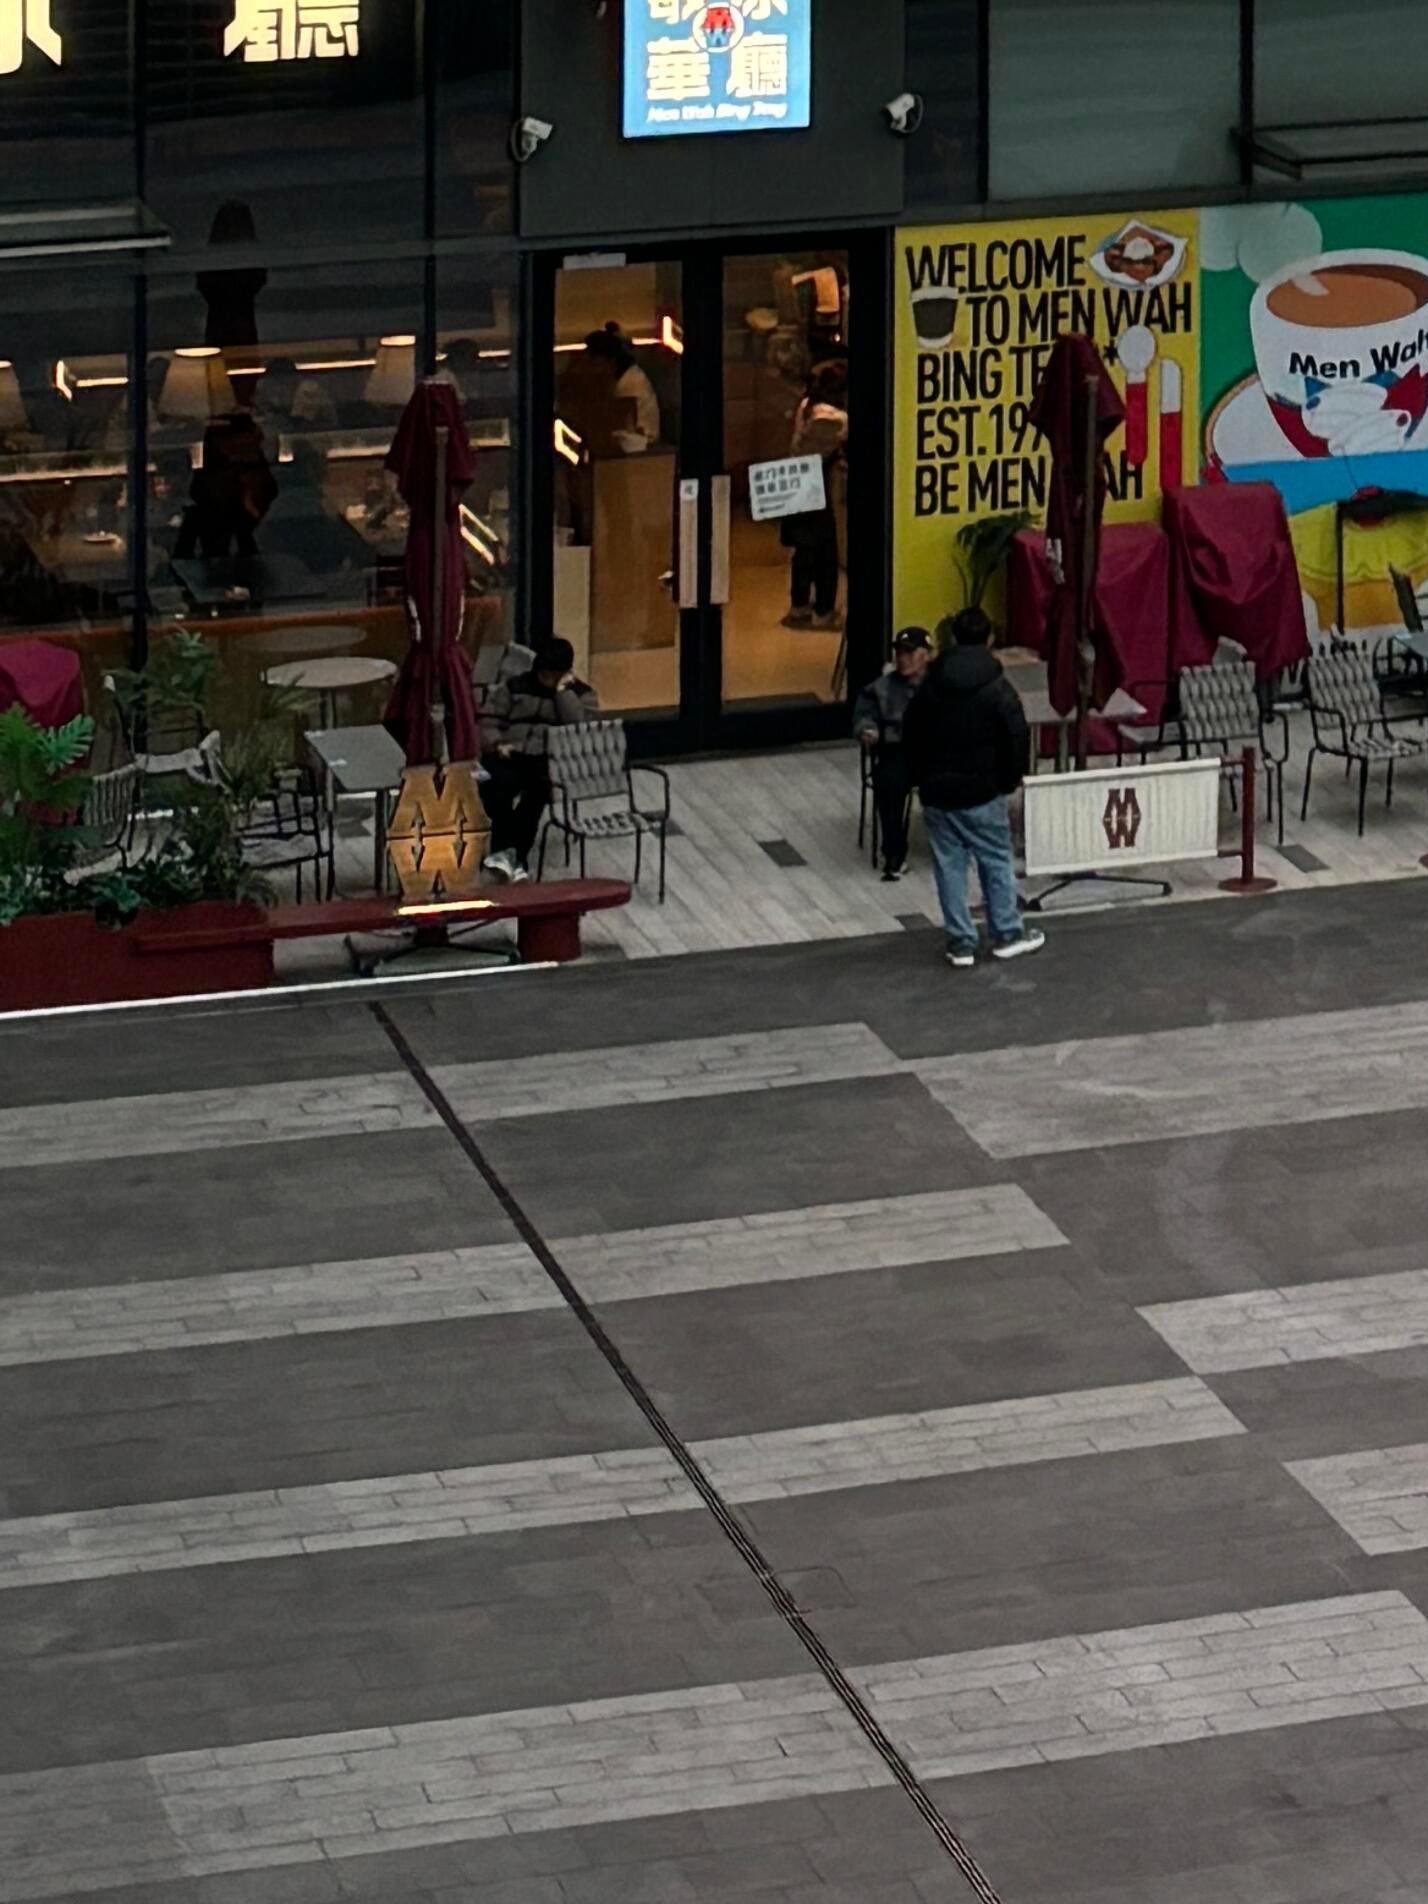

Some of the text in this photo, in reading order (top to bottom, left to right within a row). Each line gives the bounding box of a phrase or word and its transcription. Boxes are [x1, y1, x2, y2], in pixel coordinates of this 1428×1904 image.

[905, 233, 1087, 293] WELCOME
[966, 280, 1192, 348] TO MEN WAH
[916, 347, 1002, 405] BING
[1288, 351, 1361, 379] Men
[914, 462, 961, 518] BE
[967, 454, 1046, 513] MEN
